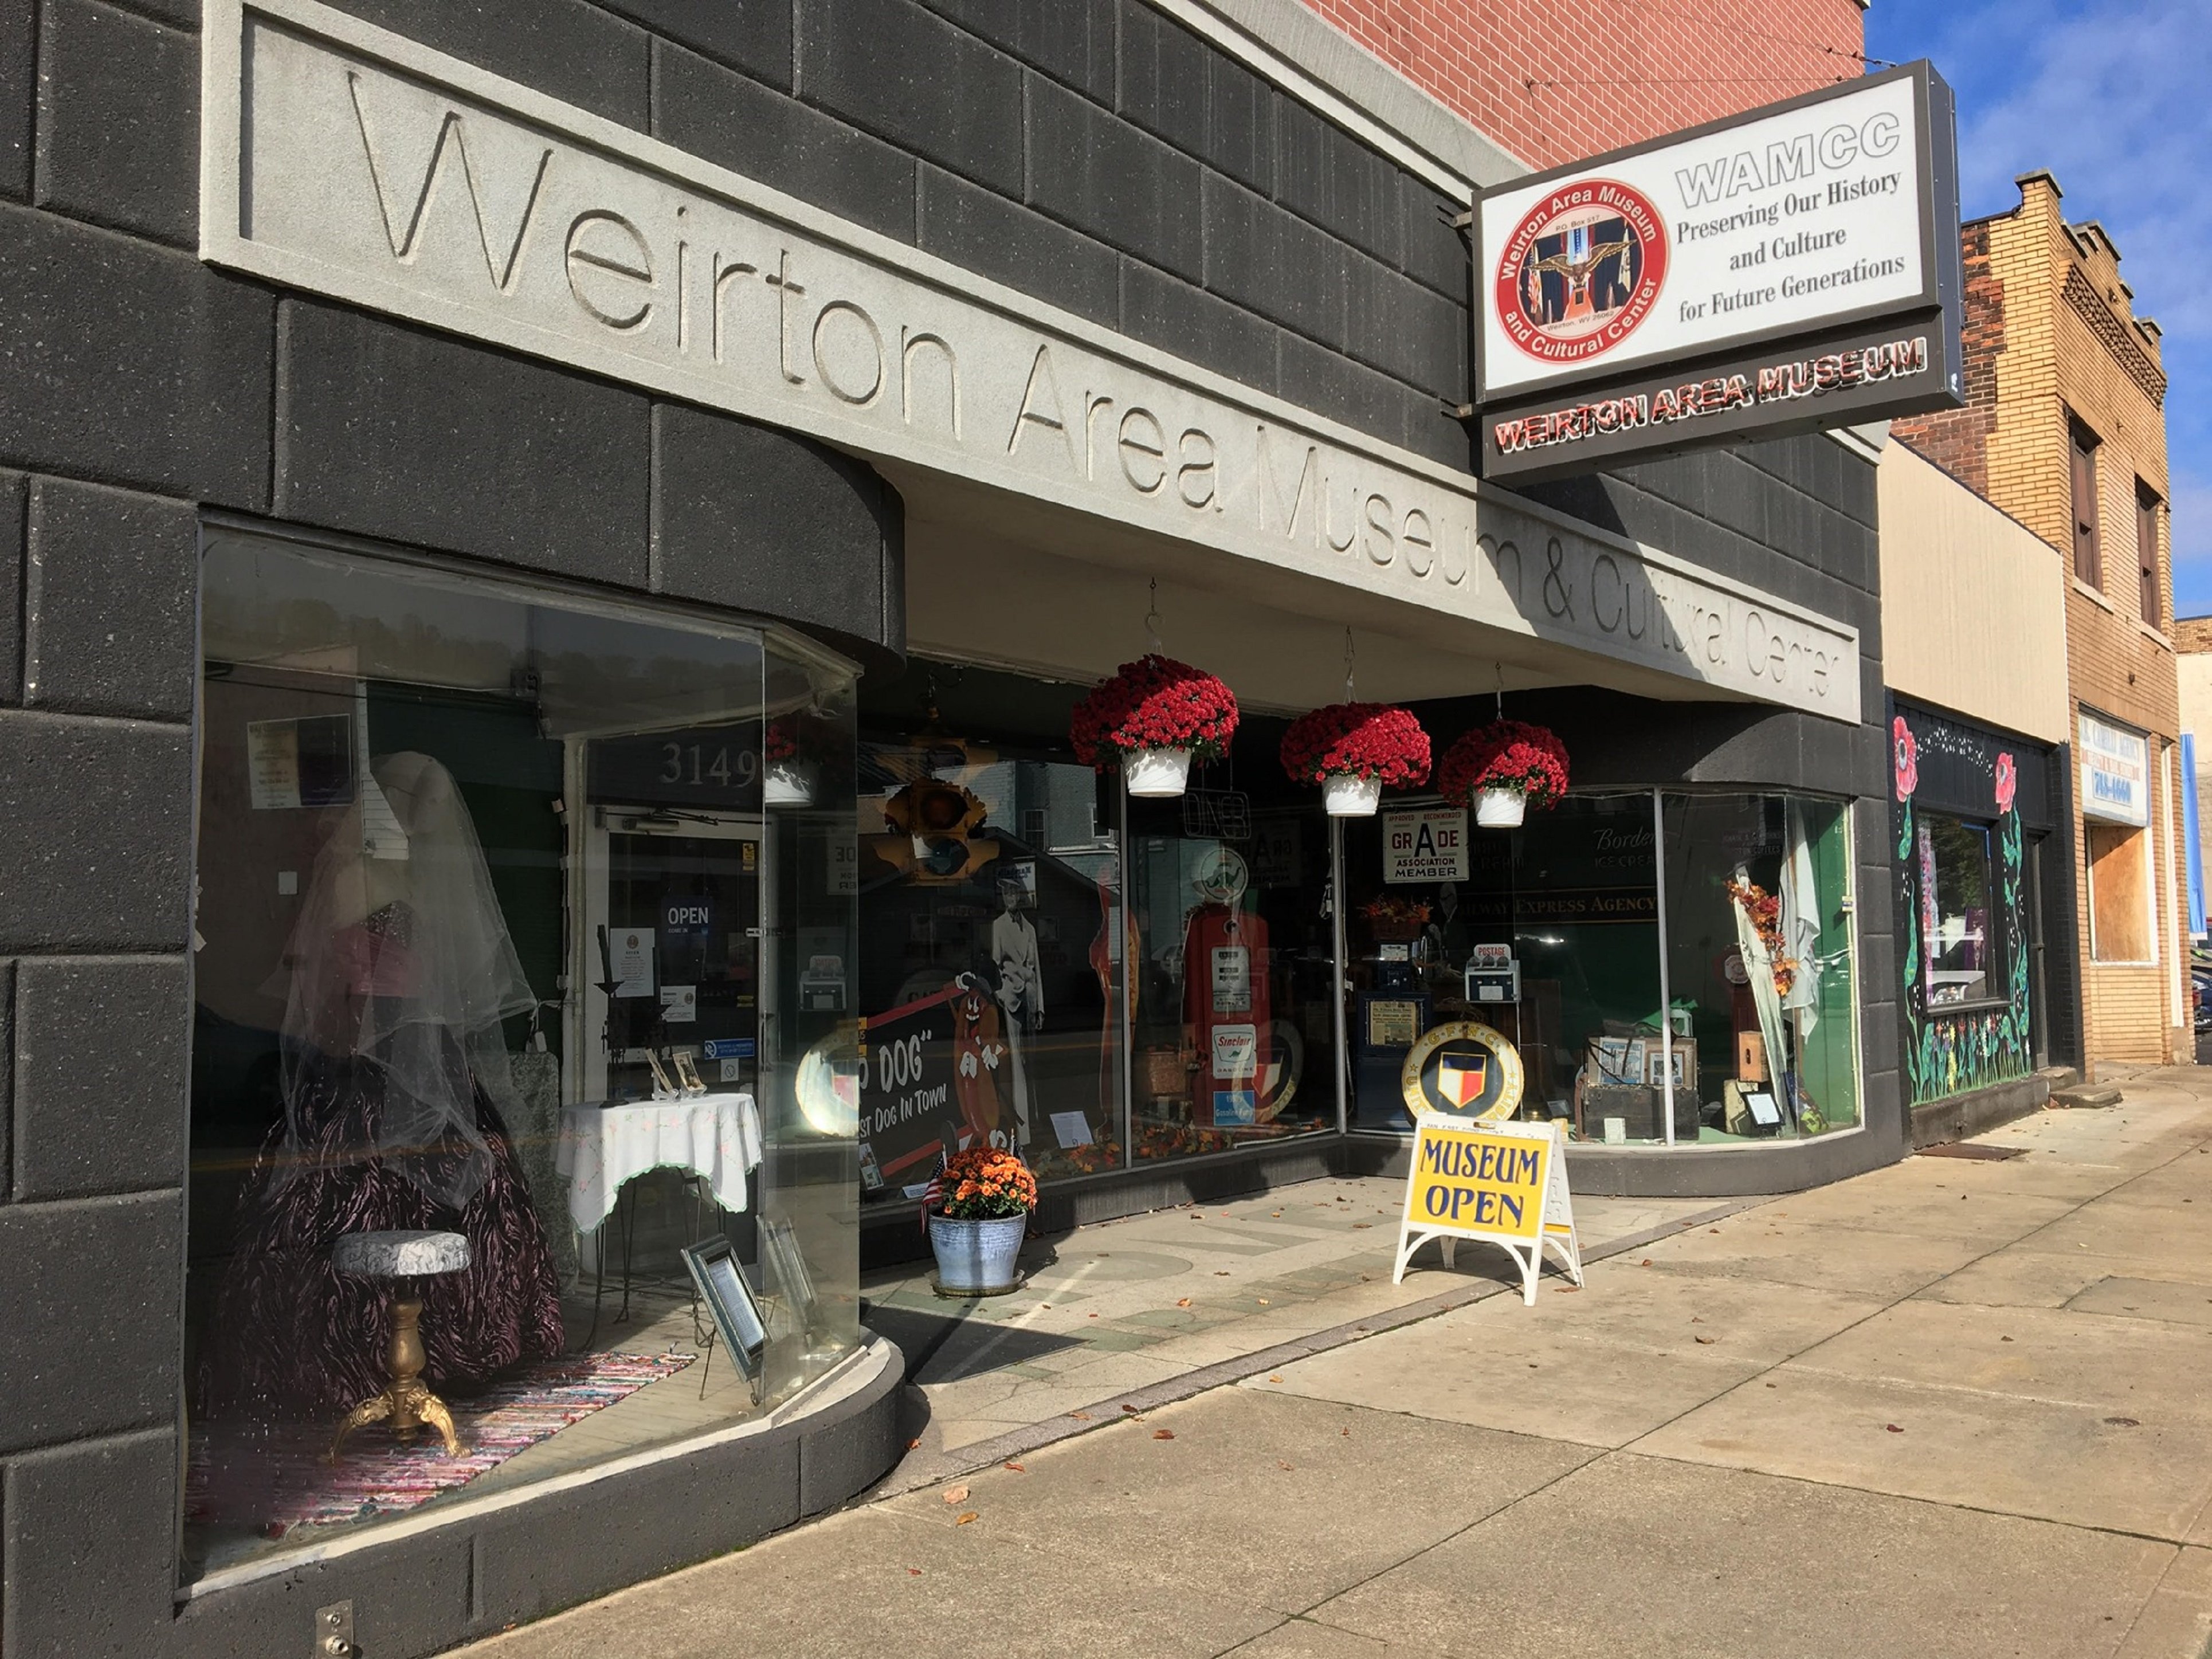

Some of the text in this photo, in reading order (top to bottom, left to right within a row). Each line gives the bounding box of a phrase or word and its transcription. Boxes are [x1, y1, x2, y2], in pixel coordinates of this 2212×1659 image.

[1674, 112, 1900, 209] WAMCC
[1571, 219, 1585, 228] Box
[1587, 215, 1600, 223] 517
[1677, 172, 1901, 244] Preserving Our History
[1501, 186, 1656, 280] Weirton Area Museum
[1729, 229, 1846, 270] and Culture
[1680, 256, 1905, 323] for Future Generations
[1506, 279, 1656, 357] and Cultural Center
[1579, 316, 1590, 324] WV
[348, 69, 1841, 697] Weirton Area Museum & Cultural Center
[1495, 336, 1928, 454] WEIRTON AREA MUSEUM
[659, 742, 757, 787] 3149
[1423, 811, 1461, 820] RECOMMENDED
[1392, 823, 1458, 857] GRADE
[1595, 854, 1655, 867] ICE CREA
[1395, 868, 1457, 877] MEMBER
[1397, 858, 1454, 866] ASSOCIATION
[668, 907, 708, 924] OPEN
[1515, 898, 1586, 915] EXPRESS
[1590, 896, 1657, 912] AGENCY
[1478, 947, 1505, 956] POSTAGE
[1218, 1036, 1251, 1046] Sinclair
[876, 1105, 897, 1133] DOG
[915, 1083, 947, 1115] TOWN
[1420, 1139, 1540, 1186] MUSEUM
[1426, 1185, 1524, 1227] OPEN
